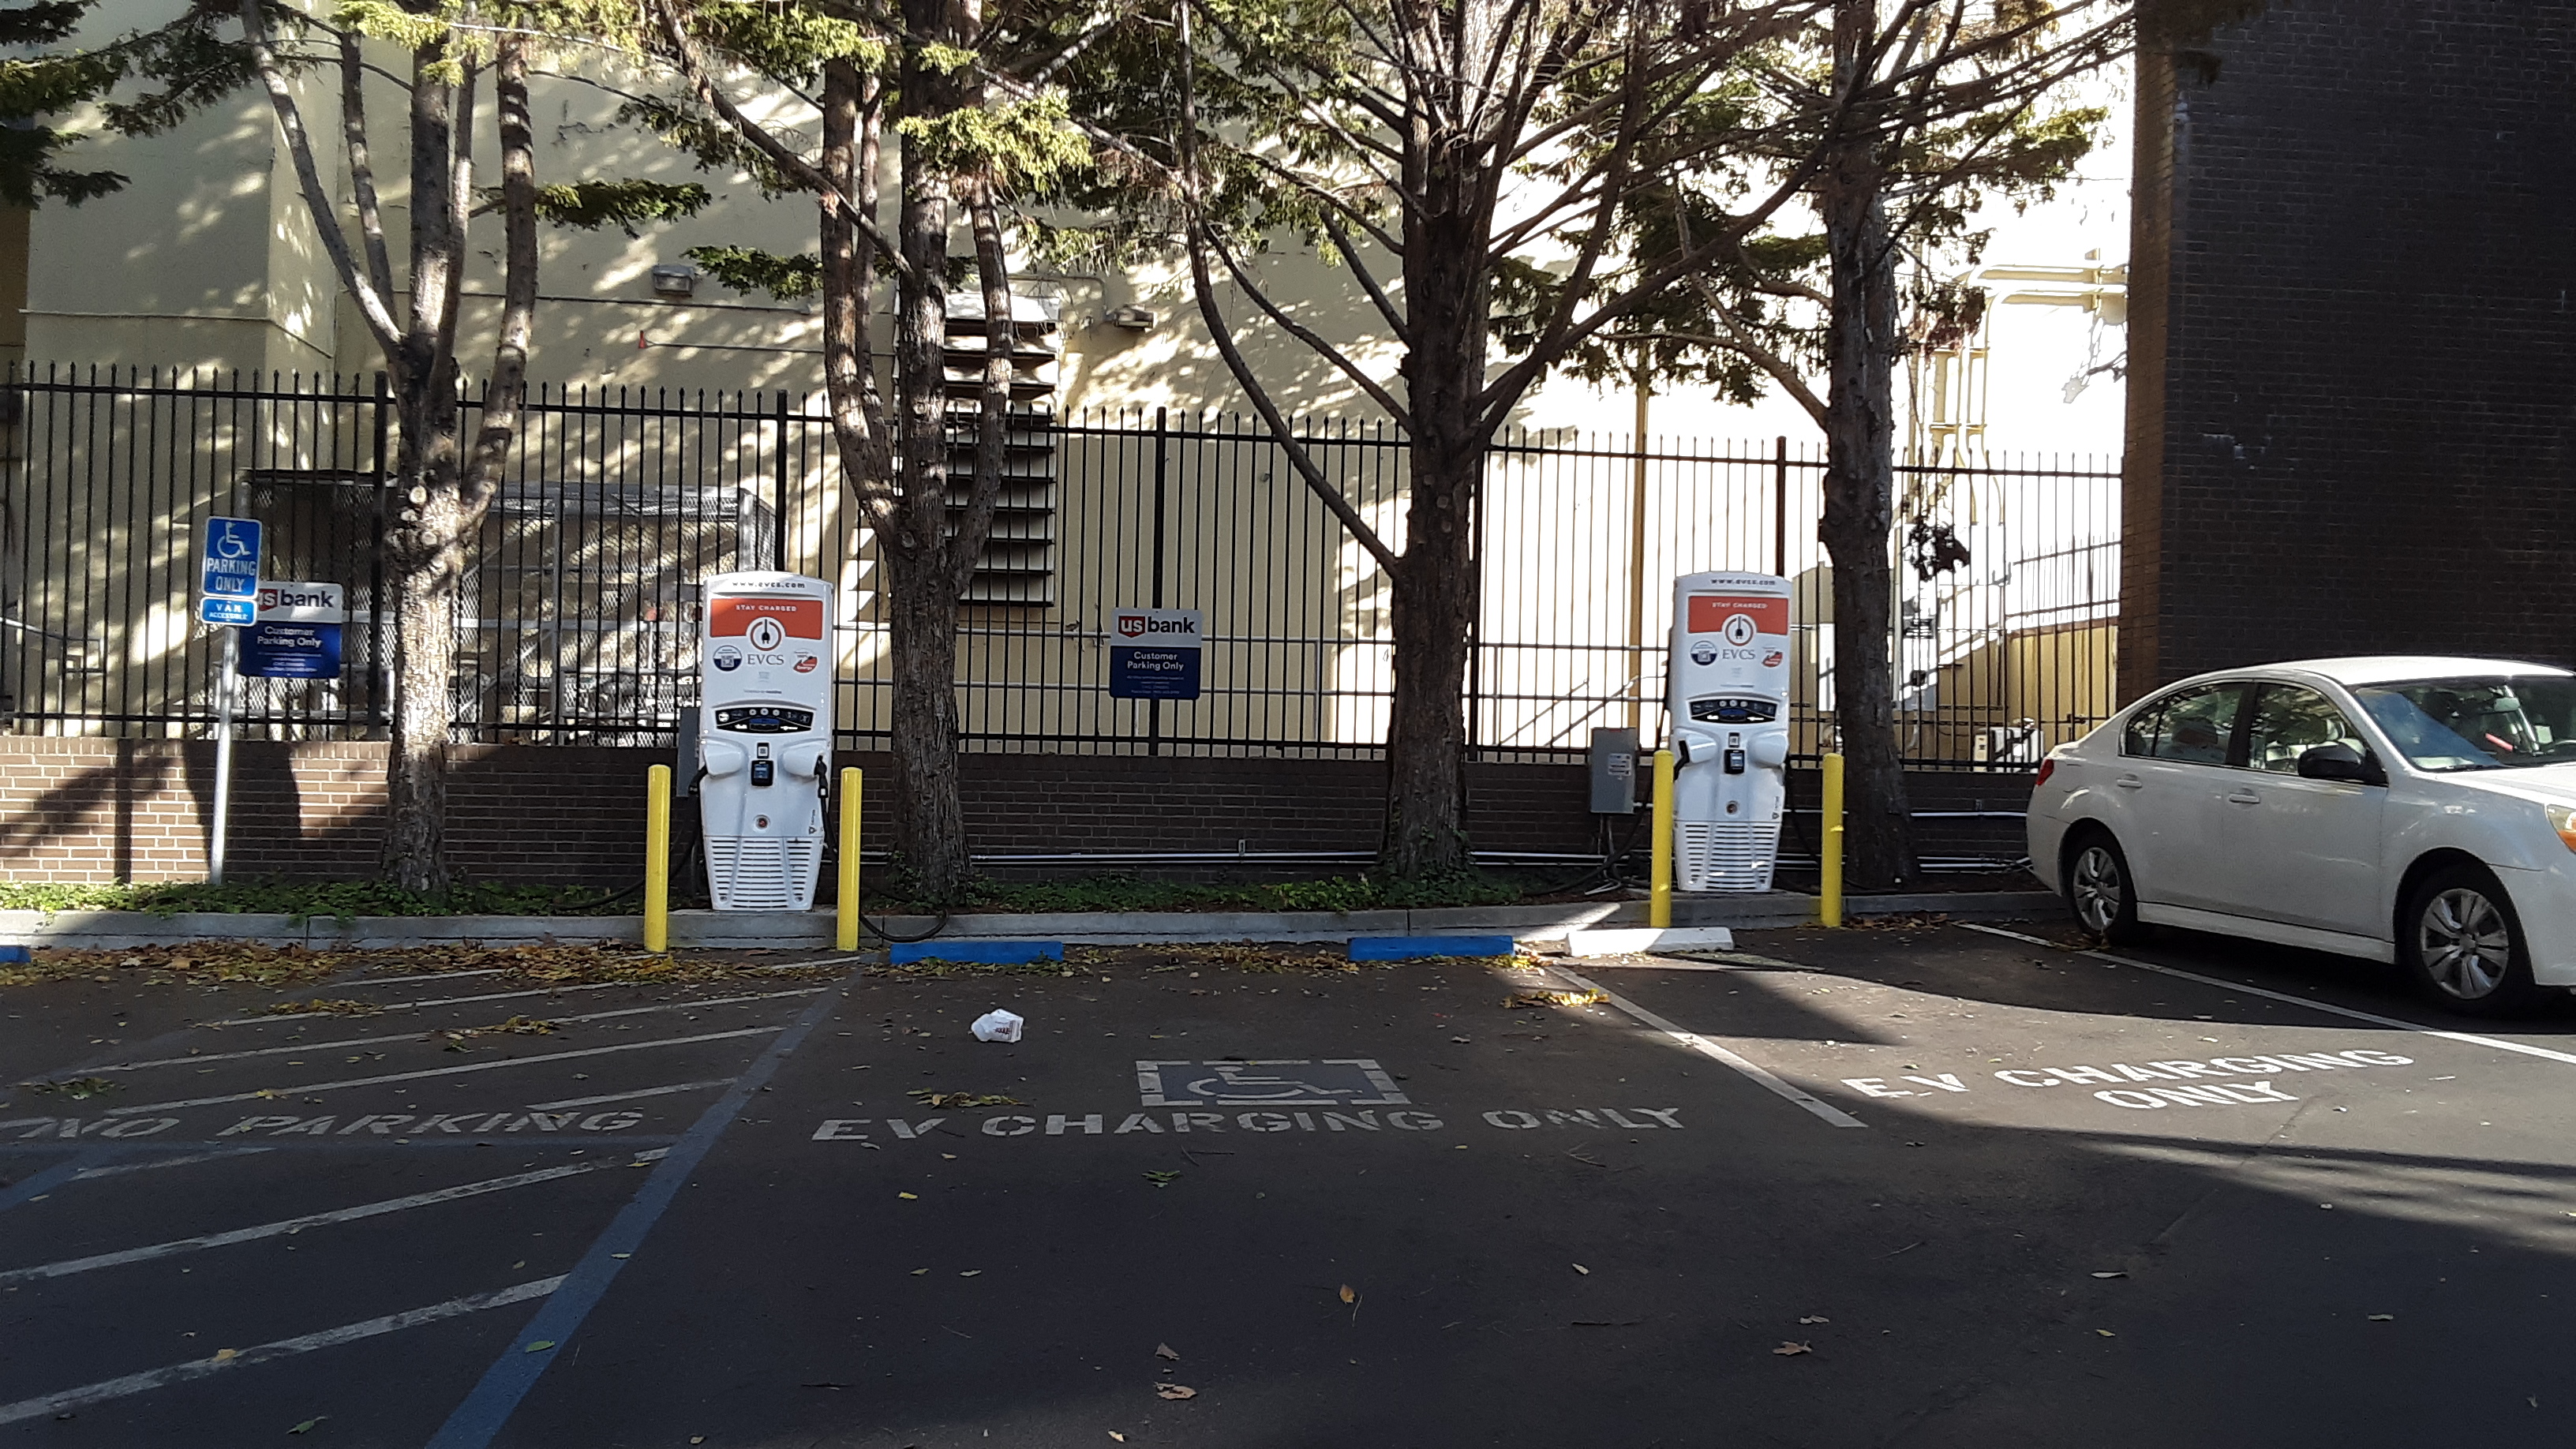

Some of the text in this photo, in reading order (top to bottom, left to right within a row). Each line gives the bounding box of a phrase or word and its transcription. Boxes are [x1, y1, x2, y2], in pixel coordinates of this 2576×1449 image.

[207, 557, 256, 576] PARKING
[215, 575, 245, 592] ONLY
[280, 589, 334, 608] bank
[216, 603, 242, 613] VAN
[208, 612, 249, 620] ACCESSIBLE
[264, 626, 315, 636] Customer
[1147, 616, 1196, 634] bank
[256, 635, 322, 648] Parking Only
[747, 653, 784, 665] EVCS
[1133, 651, 1178, 661] Customer
[1722, 649, 1755, 660] EVCS
[1127, 661, 1185, 672] Parking Only
[1840, 1049, 2415, 1098] EV CHARGING
[2093, 1080, 2300, 1108] ONLY
[215, 1110, 645, 1138] PARKING
[811, 1107, 1686, 1140] EV CHARGING ONLY
